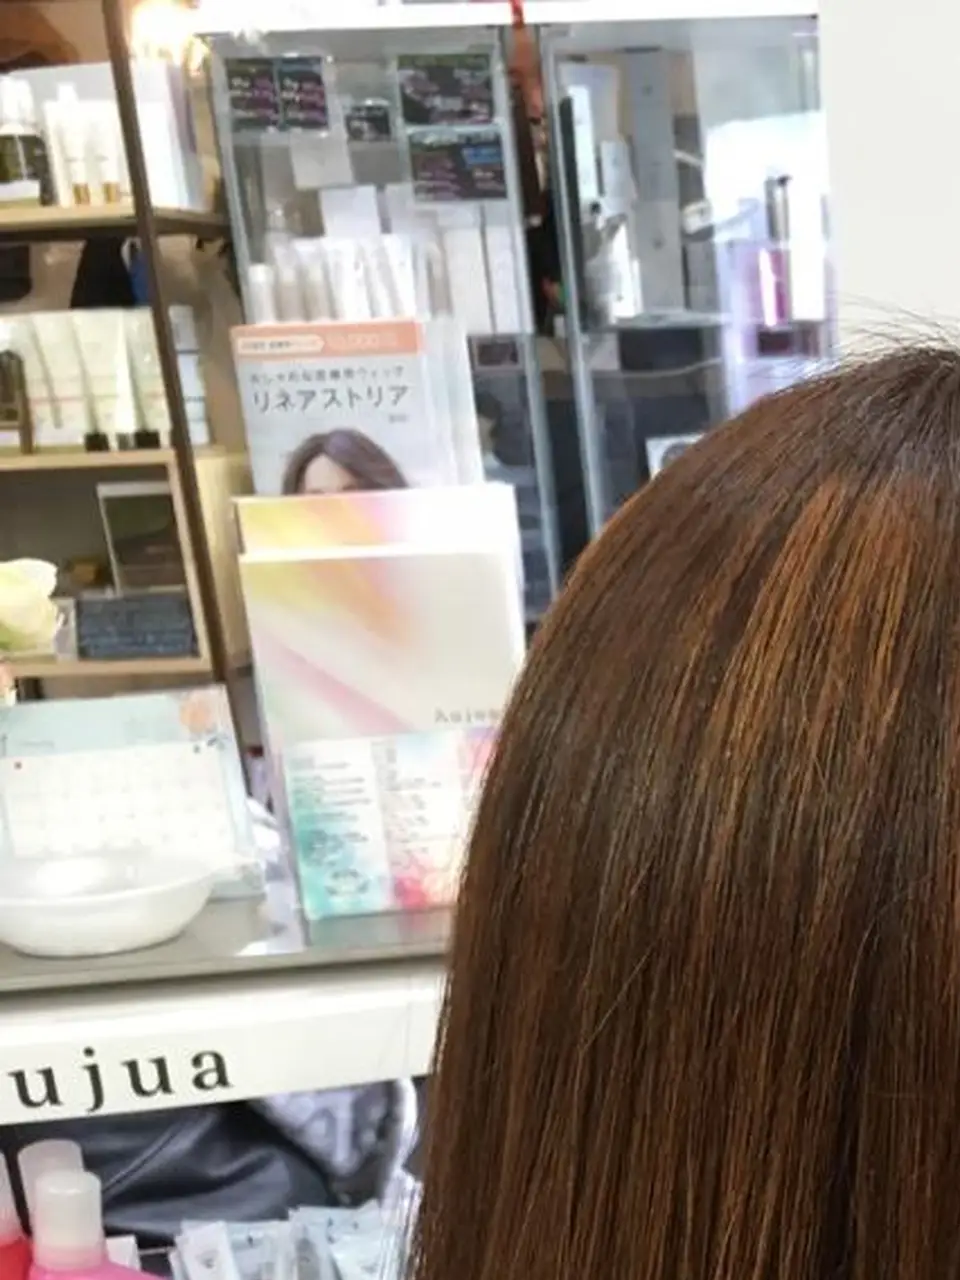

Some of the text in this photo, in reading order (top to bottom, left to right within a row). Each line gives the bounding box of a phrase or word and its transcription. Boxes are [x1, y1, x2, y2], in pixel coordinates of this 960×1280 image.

[253, 384, 408, 413] リネアストリア
[8, 1046, 234, 1113] ujua
